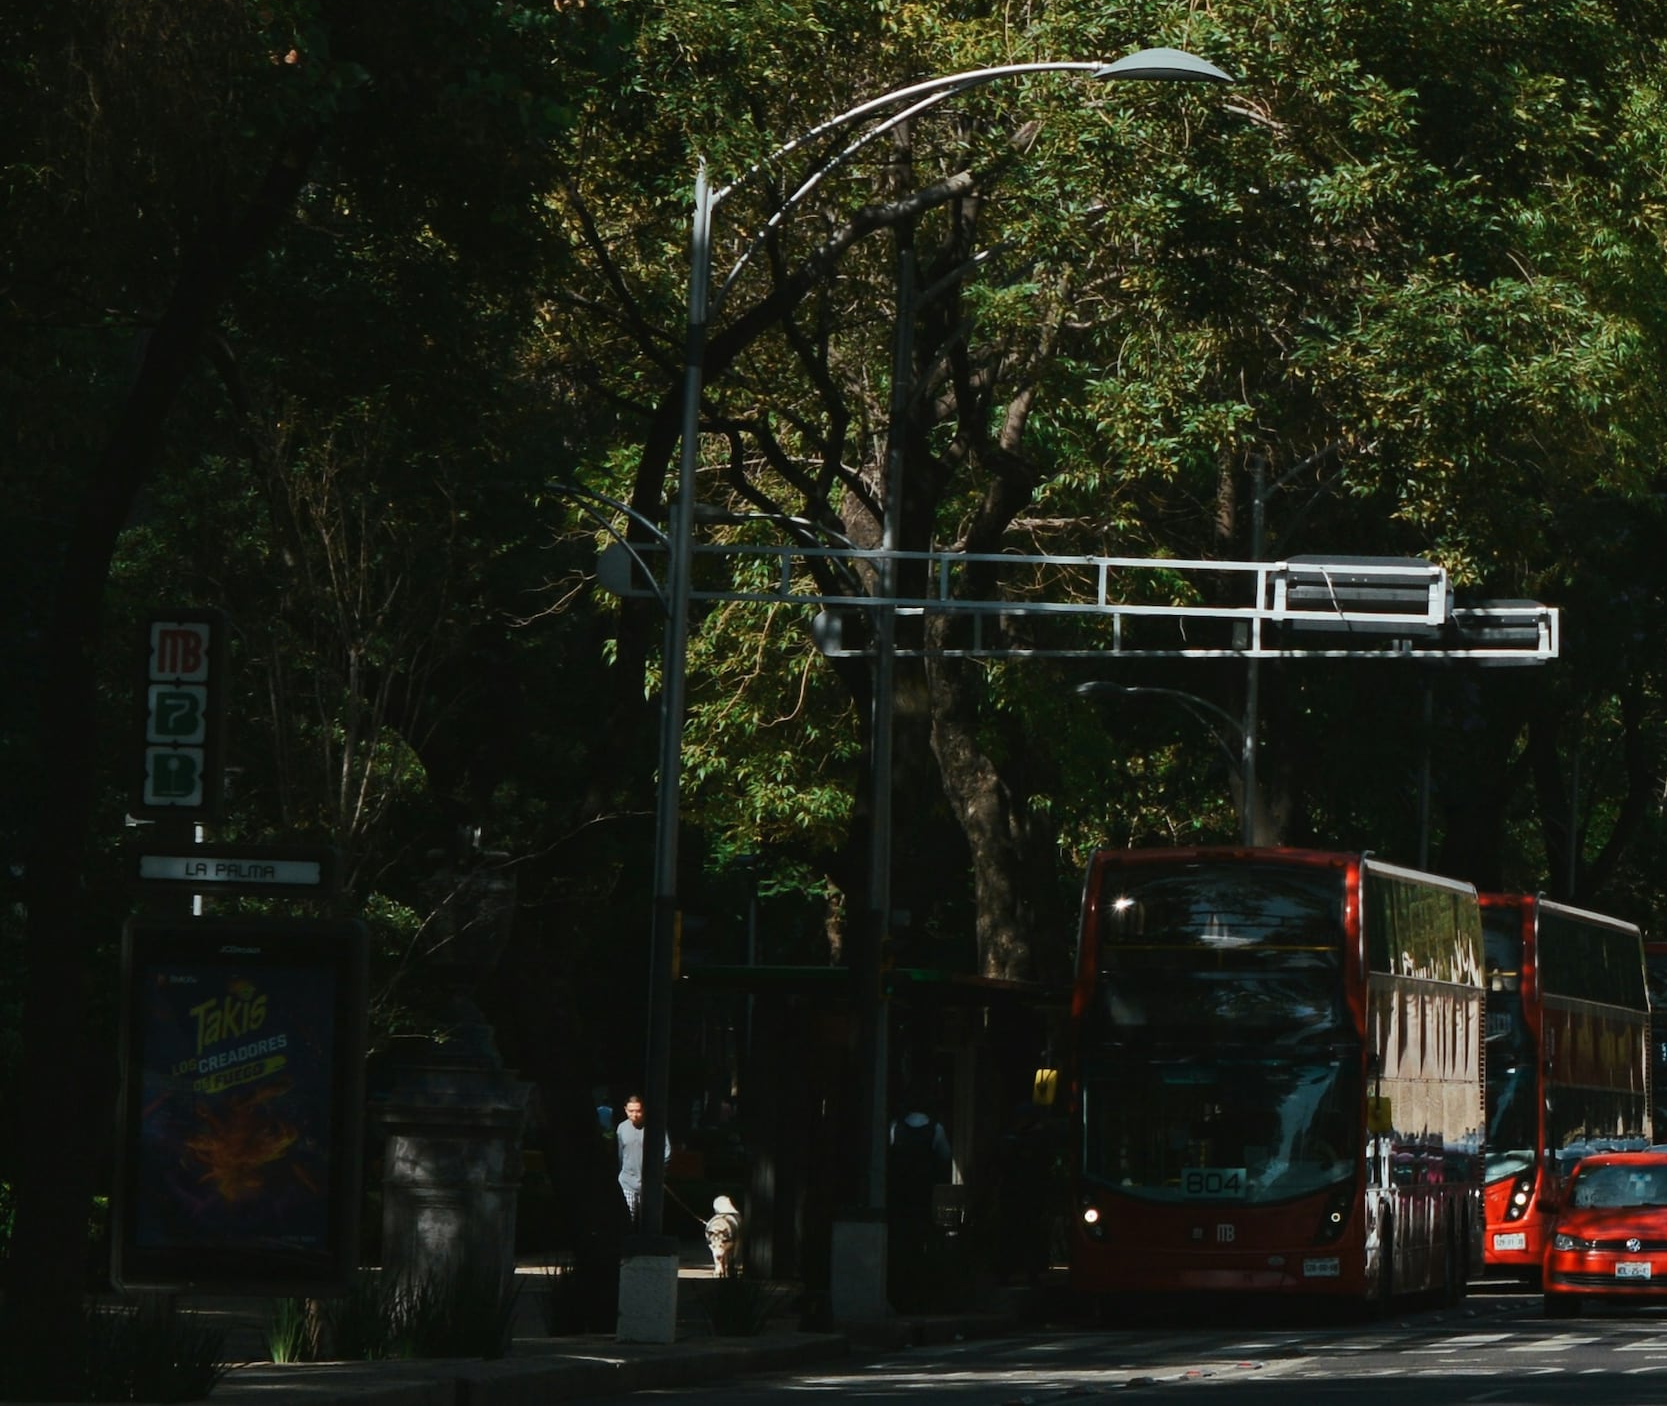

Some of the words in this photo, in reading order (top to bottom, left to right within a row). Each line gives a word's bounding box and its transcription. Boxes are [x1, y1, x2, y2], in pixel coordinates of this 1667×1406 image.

[157, 629, 202, 674] MB
[186, 862, 206, 877] LA
[215, 863, 274, 878] PALMA
[189, 994, 269, 1054] Takis
[172, 1058, 197, 1077] LOS
[199, 1034, 288, 1074] CREADORES
[1186, 1172, 1240, 1194] 804
